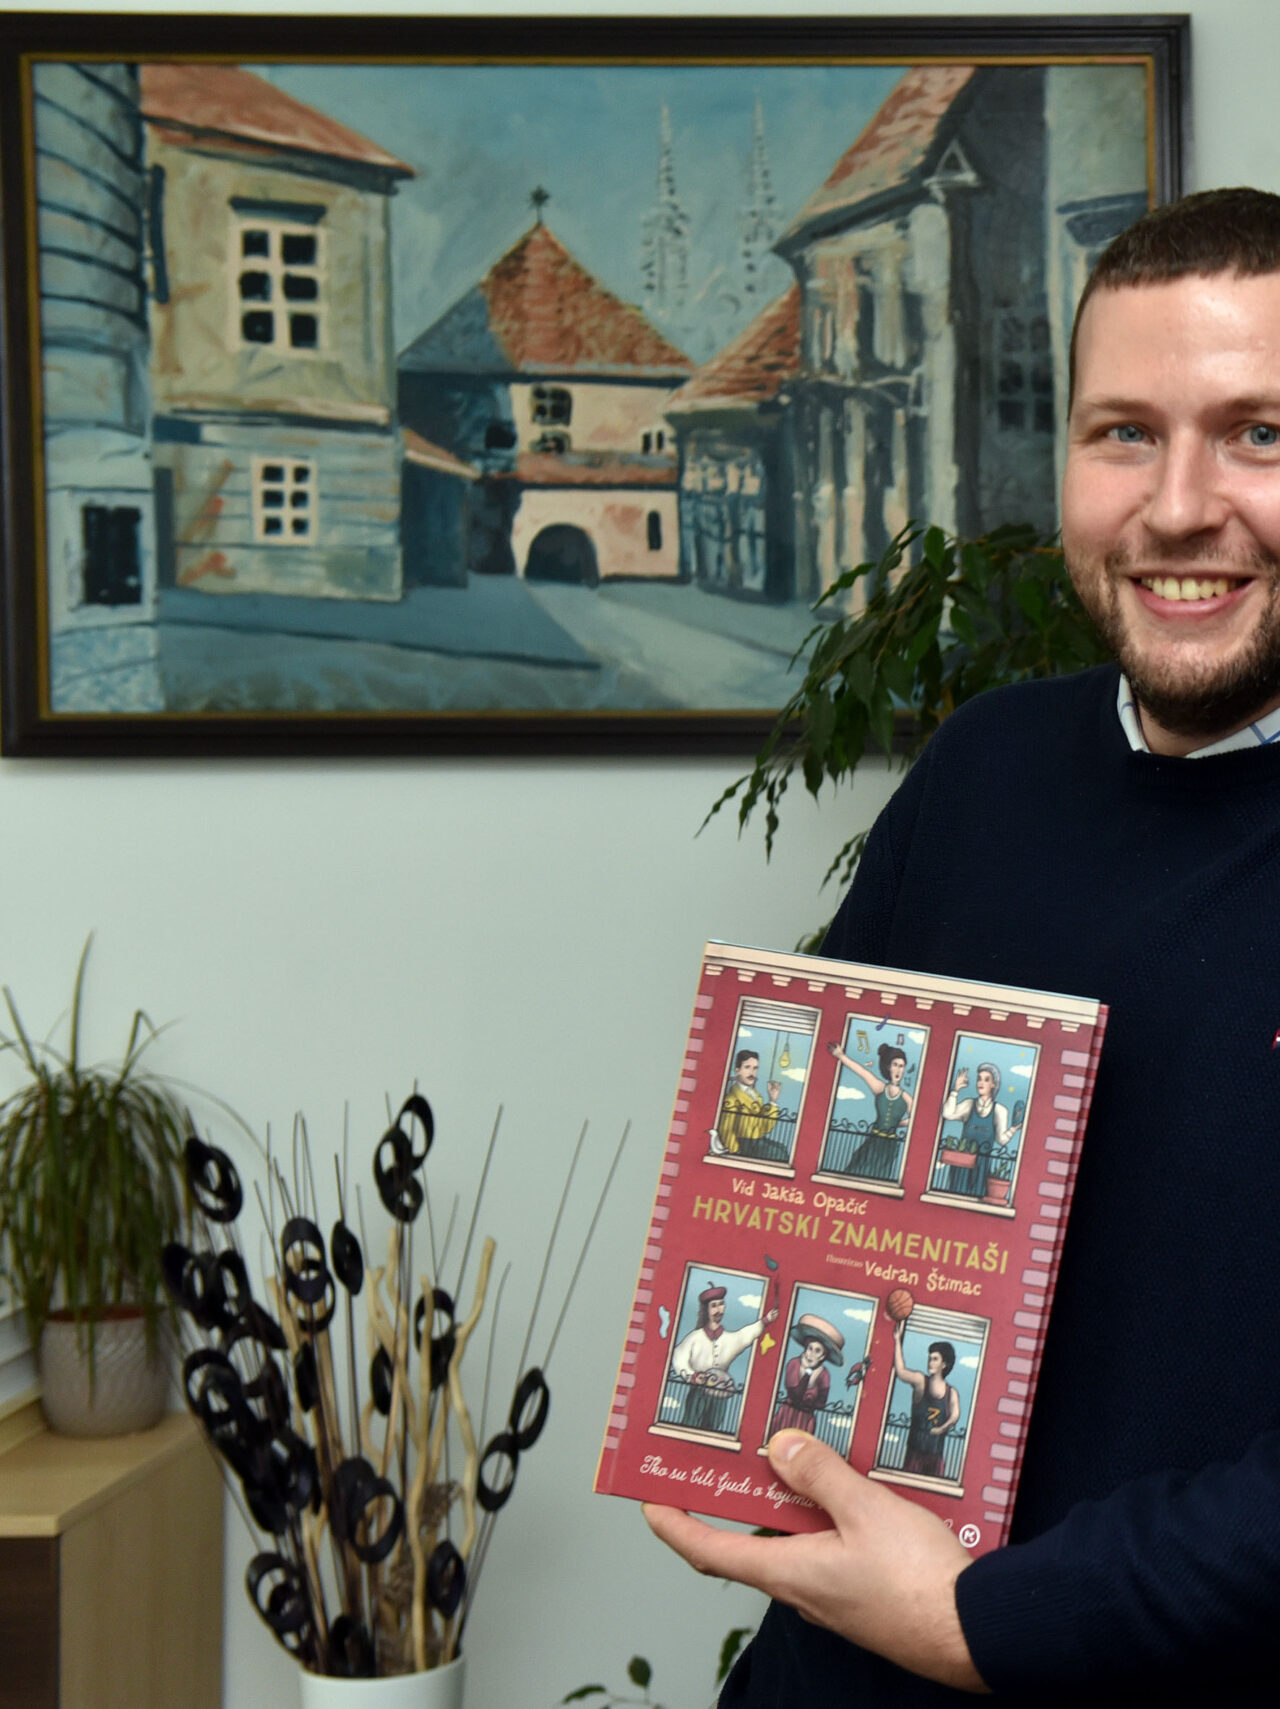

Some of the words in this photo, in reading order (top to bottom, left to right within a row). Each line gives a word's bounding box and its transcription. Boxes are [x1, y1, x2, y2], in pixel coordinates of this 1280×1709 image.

[732, 1178, 755, 1196] Vid
[761, 1182, 805, 1205] Jakša
[813, 1191, 869, 1217] Opačić
[692, 1195, 820, 1240] HRVATSKI
[828, 1219, 1009, 1275] ZNAMENITAŠI
[864, 1260, 919, 1286] Vedran
[926, 1267, 982, 1296] Štimac
[640, 1455, 667, 1477] Tko
[669, 1467, 688, 1481] su
[689, 1466, 716, 1487] bili
[714, 1472, 752, 1497] ljudi
[752, 1486, 763, 1496] o
